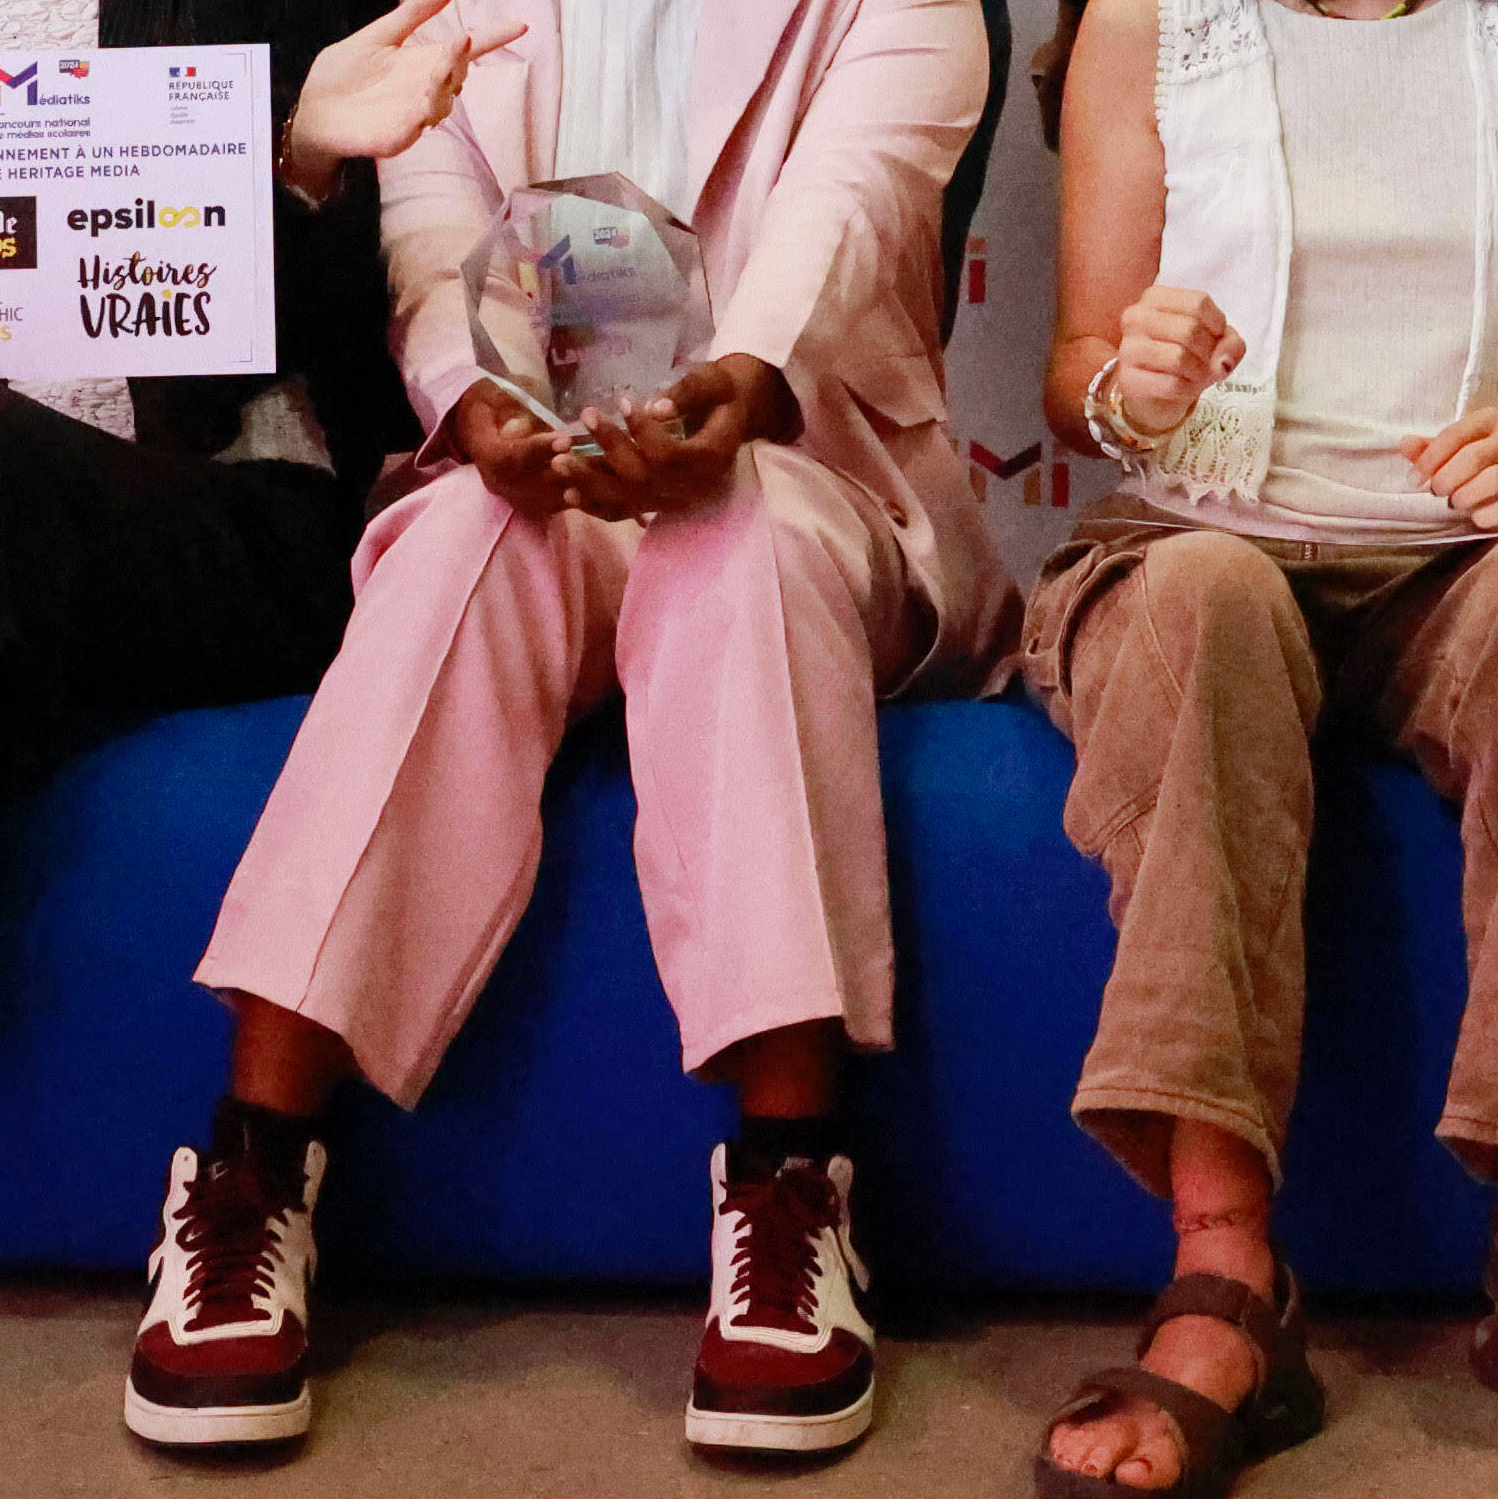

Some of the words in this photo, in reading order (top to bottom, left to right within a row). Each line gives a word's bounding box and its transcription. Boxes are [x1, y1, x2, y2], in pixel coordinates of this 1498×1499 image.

[45, 117, 91, 128] national
[76, 144, 86, 159] À
[92, 147, 113, 159] UN
[119, 143, 247, 158] HEBDOMADAIRE
[8, 166, 85, 180] HERITAGE
[90, 164, 141, 178] MEDIA
[77, 250, 218, 291] Histoires
